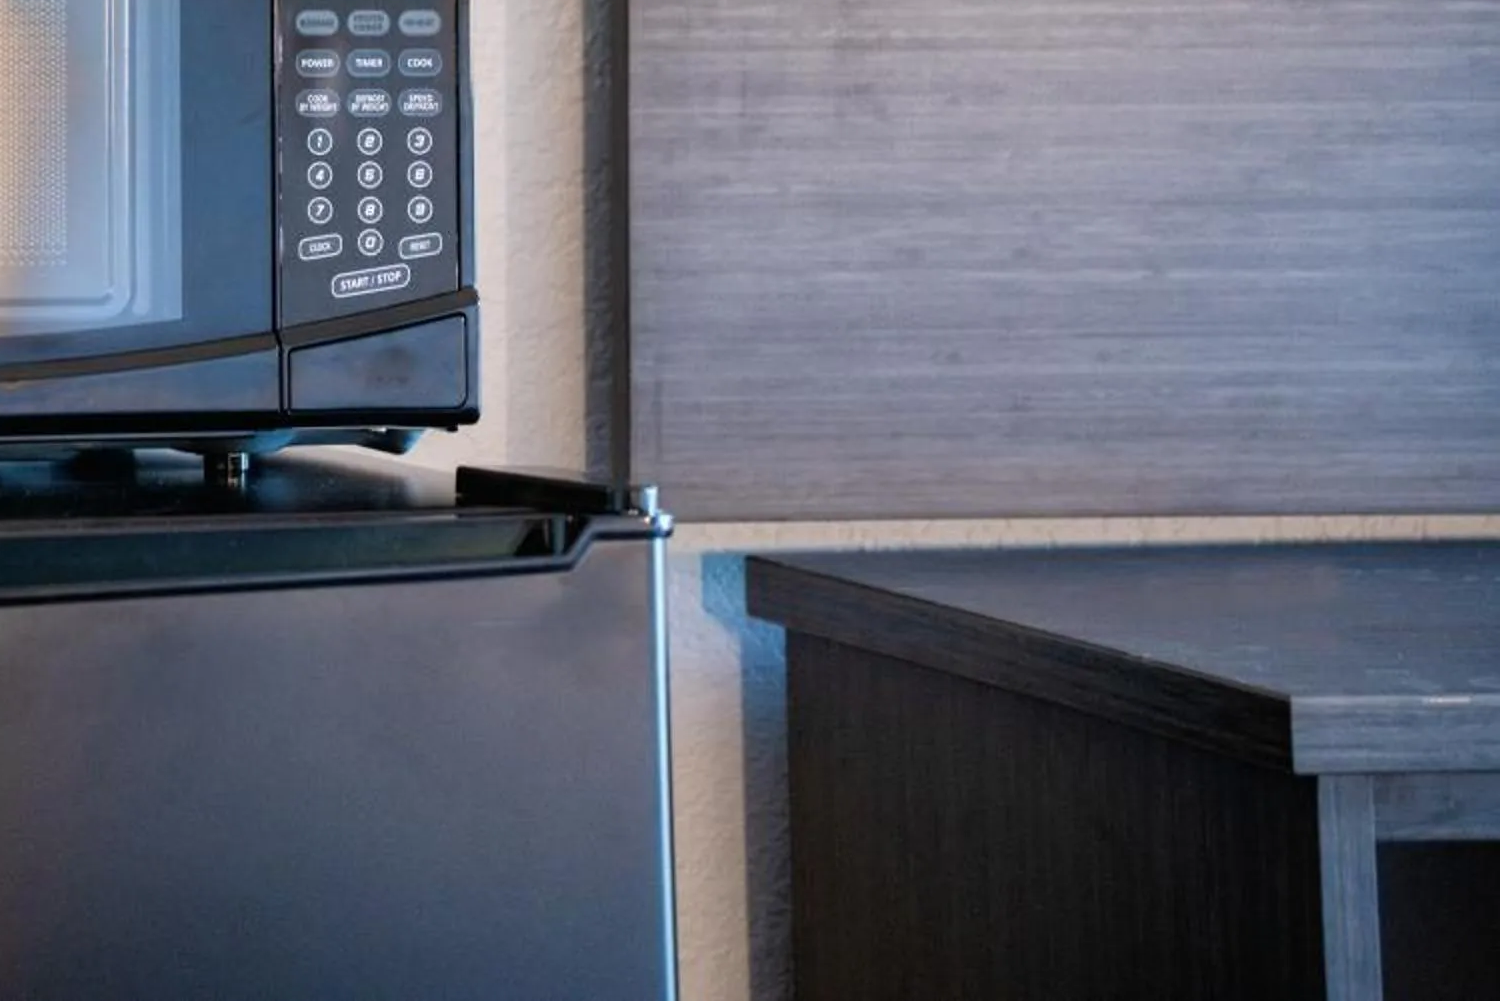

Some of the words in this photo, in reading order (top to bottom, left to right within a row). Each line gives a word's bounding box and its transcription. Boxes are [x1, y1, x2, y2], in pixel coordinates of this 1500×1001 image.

[300, 58, 334, 68] POWER
[355, 58, 383, 68] TIMER
[407, 58, 433, 68] COOK
[307, 94, 328, 103] COOK
[364, 134, 375, 148] 2
[414, 134, 425, 147] 3
[315, 169, 324, 181] 4
[364, 168, 375, 181] 5
[415, 168, 425, 180] 6
[315, 204, 325, 216] 7
[365, 203, 376, 216] 8
[415, 203, 425, 216] 9
[365, 235, 376, 249] 0
[340, 276, 369, 292] START
[377, 270, 402, 286] STOP
